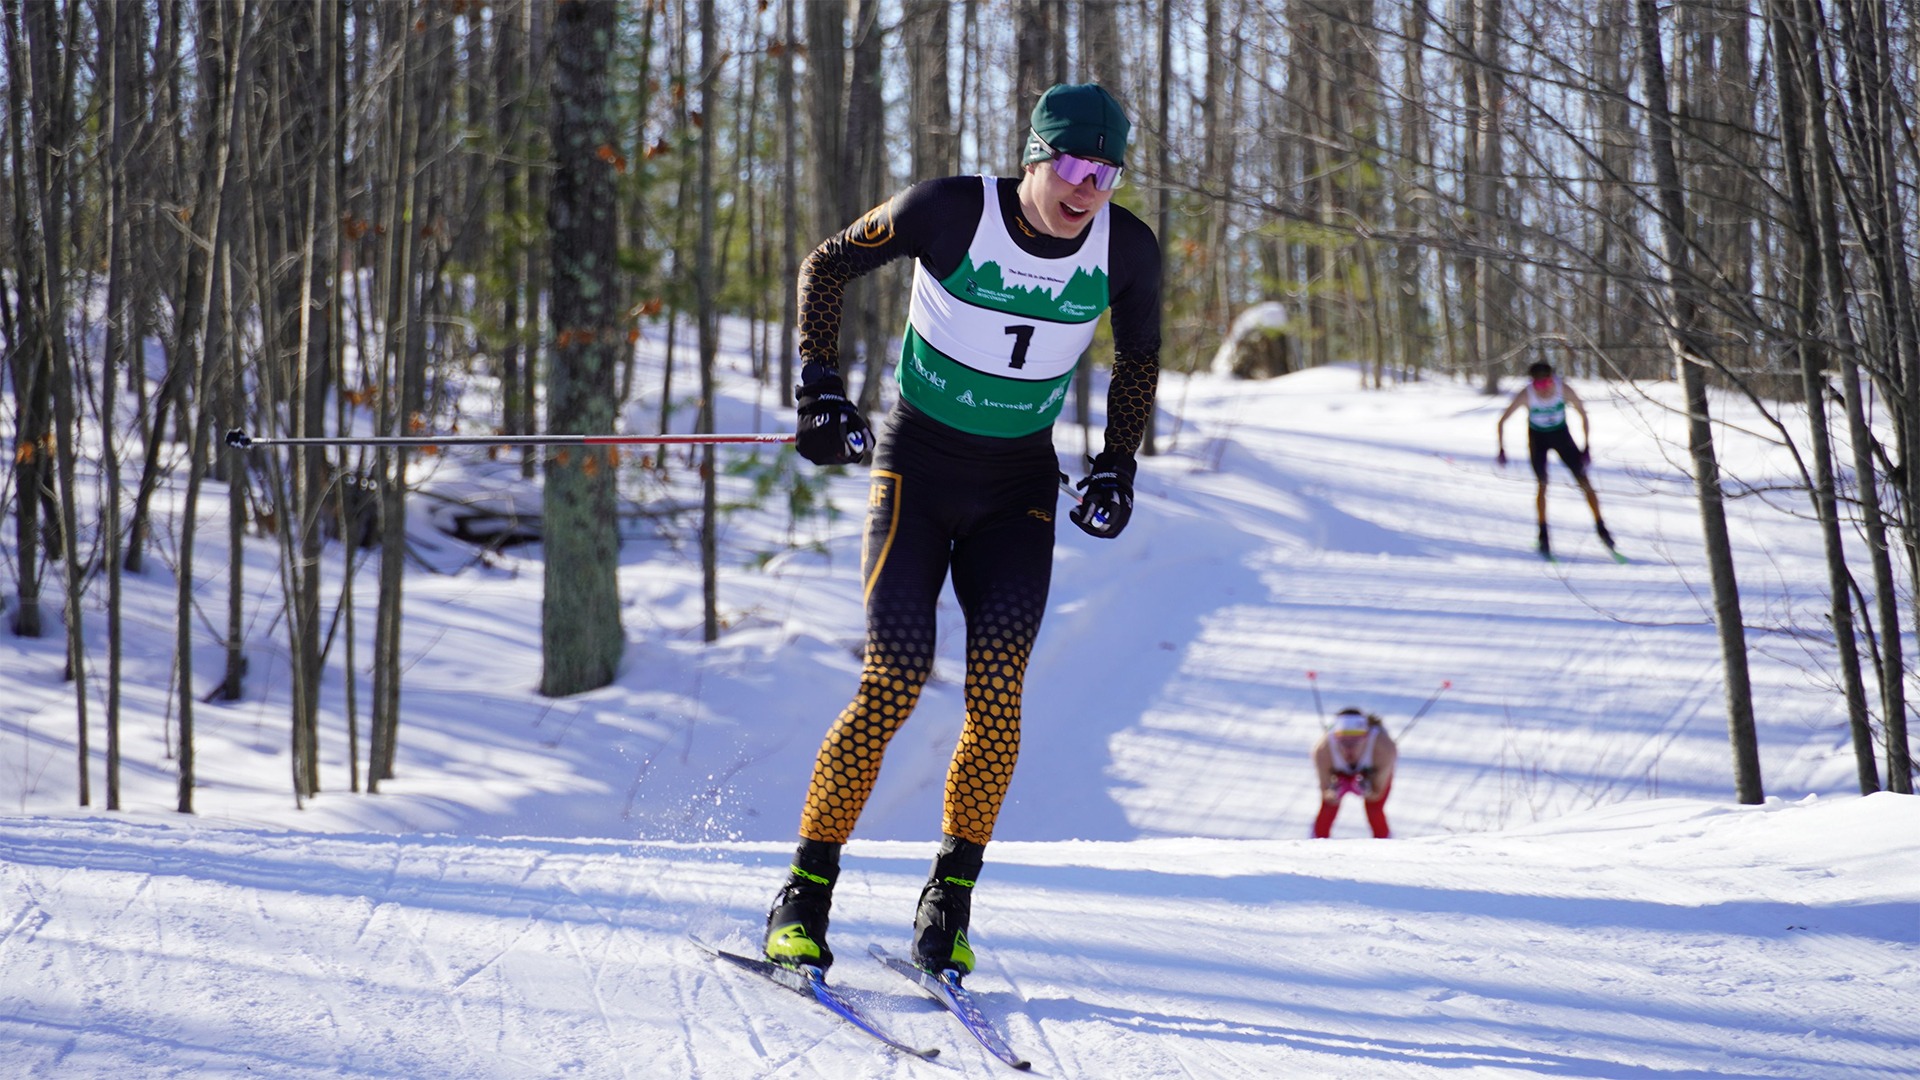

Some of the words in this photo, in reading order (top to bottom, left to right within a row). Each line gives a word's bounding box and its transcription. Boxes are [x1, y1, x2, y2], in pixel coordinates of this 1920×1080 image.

[1004, 324, 1036, 370] 1
[909, 352, 947, 390] Nicolet
[980, 398, 1034, 411] Ascension
